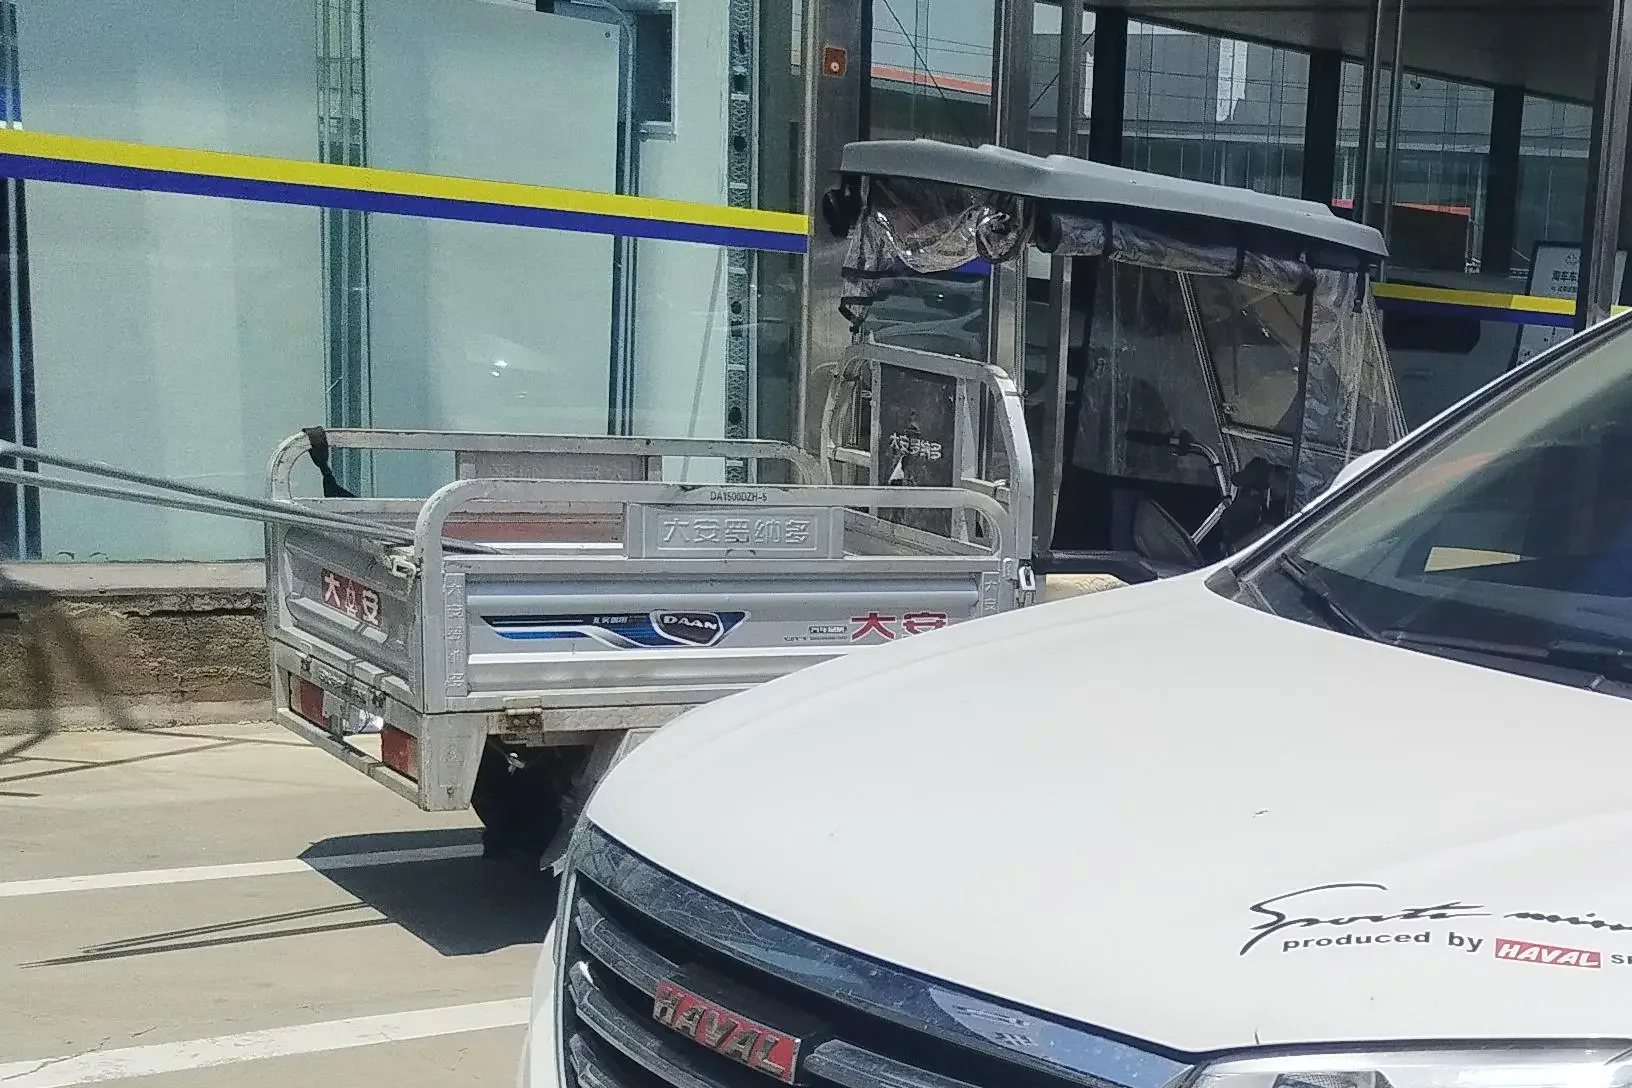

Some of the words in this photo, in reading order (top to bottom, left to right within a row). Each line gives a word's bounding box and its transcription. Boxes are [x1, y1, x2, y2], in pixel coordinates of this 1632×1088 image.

[663, 615, 718, 631] DAAN
[1282, 930, 1432, 953] produced
[1448, 930, 1484, 953] by
[1498, 942, 1600, 967] HAVAL
[652, 984, 788, 1078] HAVAL
